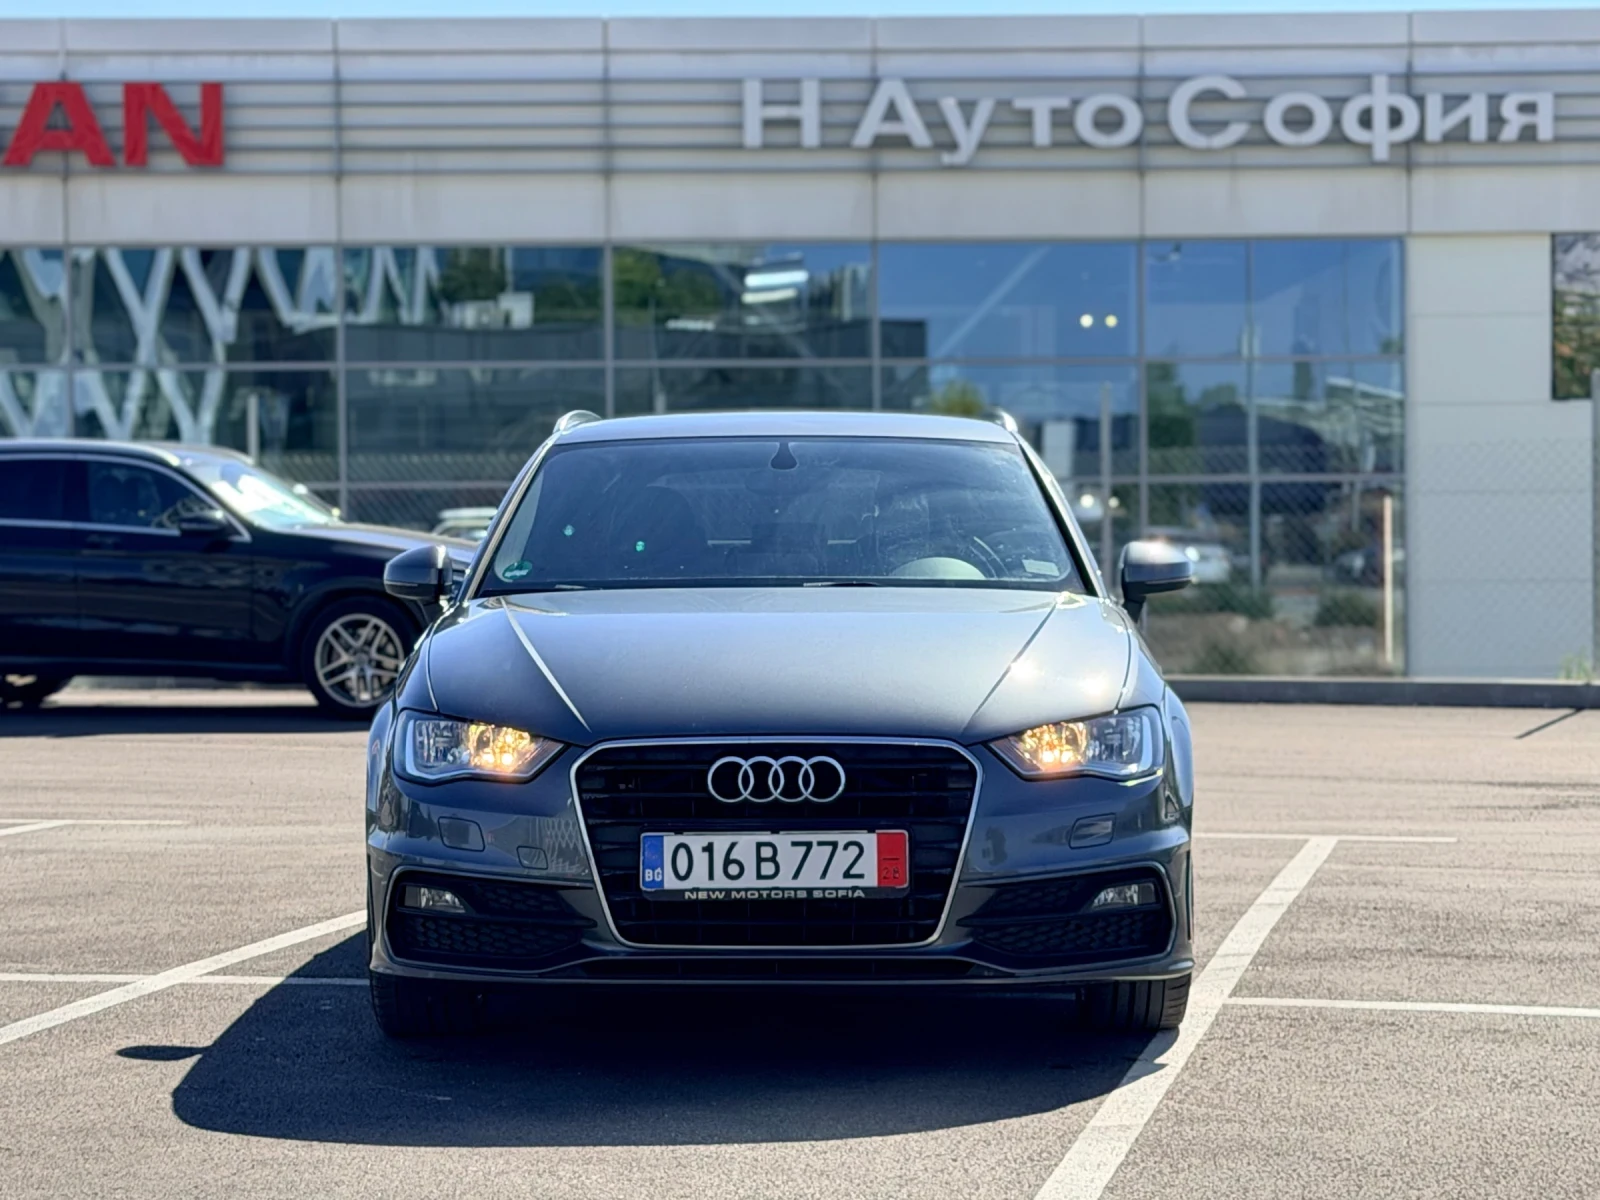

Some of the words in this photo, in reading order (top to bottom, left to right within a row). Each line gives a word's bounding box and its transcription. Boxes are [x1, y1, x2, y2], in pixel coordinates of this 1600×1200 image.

[3, 82, 224, 166] AN
[645, 867, 662, 881] BG
[684, 891, 725, 900] NEW
[731, 890, 808, 899] MOTORS
[812, 889, 866, 899] SOFIA
